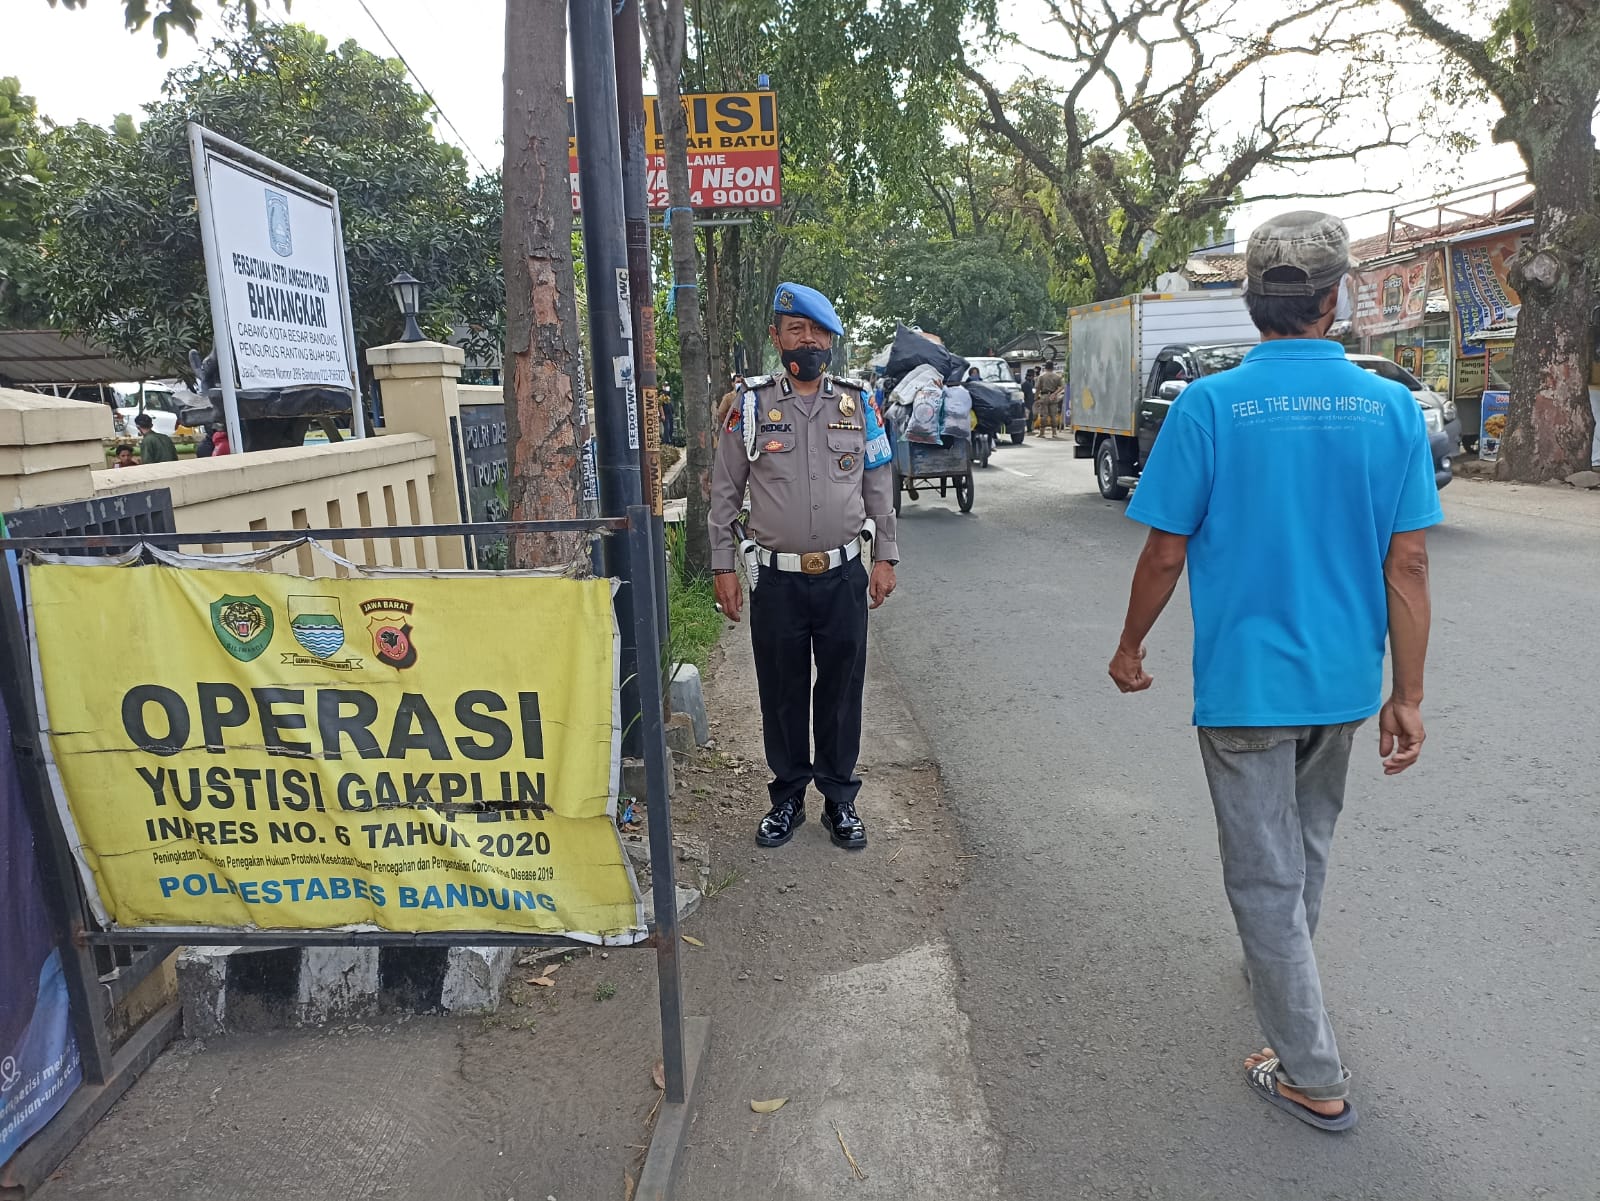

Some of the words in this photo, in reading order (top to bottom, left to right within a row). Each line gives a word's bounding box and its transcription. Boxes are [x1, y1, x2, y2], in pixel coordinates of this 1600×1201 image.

[655, 136, 712, 150] BAH
[720, 135, 775, 149] BATU
[654, 154, 726, 166] RLAME
[702, 166, 774, 189] NEON
[713, 189, 776, 205] 9000
[232, 252, 271, 280] PERSATUAN
[271, 264, 288, 286] ISTRI
[288, 267, 314, 290] ANGGOTA
[313, 274, 329, 294] POLRI
[1480, 247, 1496, 276] BATAS
[247, 282, 327, 328] BHAYANGKARI
[1475, 262, 1505, 321] SEPTEMBER
[238, 322, 269, 339] CABANG
[268, 328, 287, 341] KOTA
[288, 329, 309, 343] BESAR
[309, 332, 338, 346] BANDUNG
[239, 342, 280, 359] PENGURUS
[280, 346, 309, 361] RANTING
[309, 349, 326, 361] BUAH
[325, 350, 341, 362] BATU
[626, 382, 637, 406] WC
[644, 390, 655, 410] WC
[1231, 399, 1264, 418] FEEL
[1265, 396, 1290, 413] THE
[1291, 396, 1332, 412] LIVING
[1335, 396, 1387, 417] HISTORY
[466, 424, 490, 450] POLRI
[626, 406, 637, 447] SEDOT
[644, 411, 655, 449] SEDOT
[363, 601, 382, 612] JAWA
[383, 601, 408, 610] BARAT
[121, 682, 545, 761] OPERASI
[135, 766, 326, 813] YUSTISI
[337, 771, 546, 823] GAKPLIN
[146, 816, 259, 845] INPRES
[268, 821, 326, 844] NO.
[335, 825, 351, 846] 6
[477, 831, 551, 858] 2020
[153, 849, 198, 864] Peningkatan
[226, 856, 265, 870] Penegakan
[266, 855, 291, 866] Hukum
[291, 853, 321, 865] Protokol
[321, 853, 356, 867] Kesehatan
[373, 859, 416, 876] Pencegahan
[416, 856, 431, 870] dan
[510, 867, 537, 881] Disease
[537, 866, 554, 881] 2019
[399, 883, 557, 912] BANDUNG
